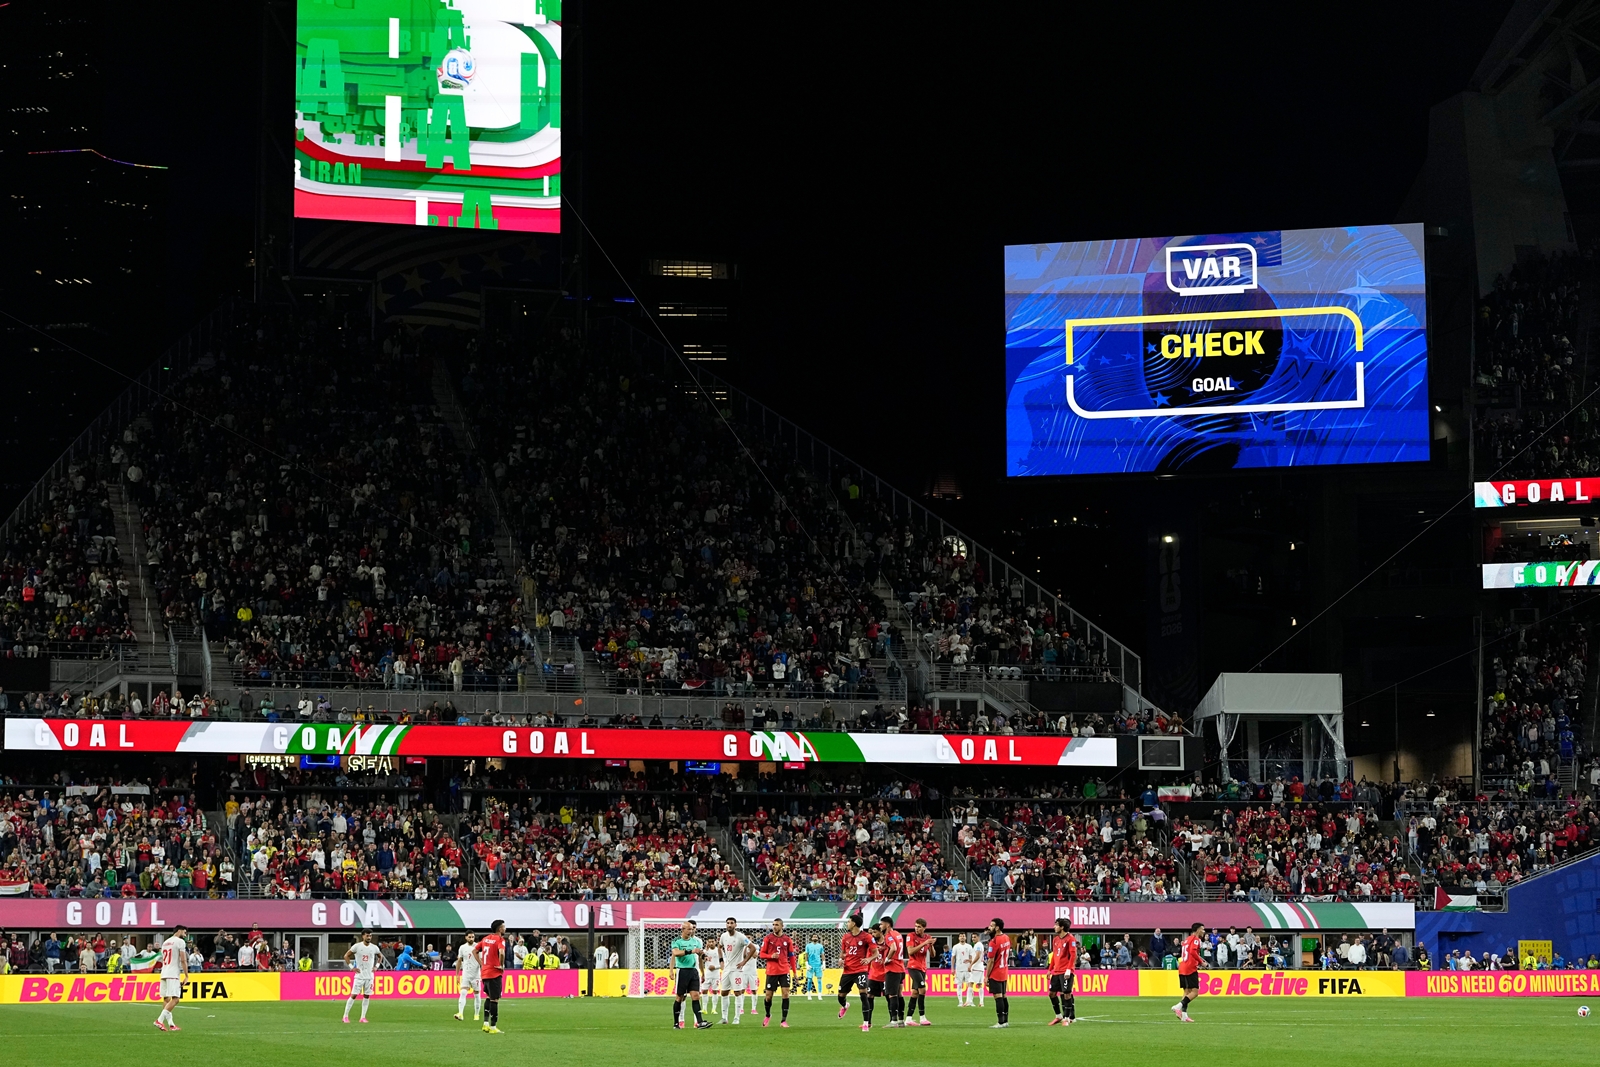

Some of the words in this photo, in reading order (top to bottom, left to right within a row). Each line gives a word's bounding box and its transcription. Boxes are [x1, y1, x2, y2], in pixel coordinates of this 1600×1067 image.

[309, 160, 361, 184] IRAN
[1182, 256, 1241, 280] VAR
[1160, 330, 1265, 359] CHECK
[1192, 376, 1235, 392] GOAL
[1502, 481, 1589, 504] GOAL
[1513, 564, 1586, 584] GOAL
[34, 723, 134, 748] GOAL
[273, 726, 370, 752] GOAL
[502, 730, 595, 755] GOAL
[723, 734, 811, 758] GOAL
[936, 738, 1022, 762] GOAL
[66, 901, 165, 925] GOAL
[312, 902, 407, 926] GOAL
[548, 903, 640, 926] GOAL
[1073, 906, 1110, 925] IRAN
[483, 946, 490, 965] 7
[776, 946, 781, 955] 5
[848, 945, 858, 955] 22
[20, 977, 68, 1002] Be
[67, 976, 161, 1002] Active
[180, 982, 228, 998] FIFA
[315, 976, 351, 996] KIDS
[398, 975, 430, 995] 60
[504, 975, 514, 993] A
[519, 974, 547, 993] DAY
[628, 972, 668, 995] Be
[1006, 974, 1048, 992] MINUT
[1082, 974, 1109, 992] DAY
[1198, 972, 1223, 995] Be
[1226, 972, 1308, 995] Active
[1318, 978, 1362, 994] FIFA
[1427, 975, 1459, 993] KIDS
[1461, 975, 1495, 993] NEED
[1498, 974, 1526, 993] 60
[1530, 974, 1588, 993] MINUTES
[1590, 974, 1600, 992] A
